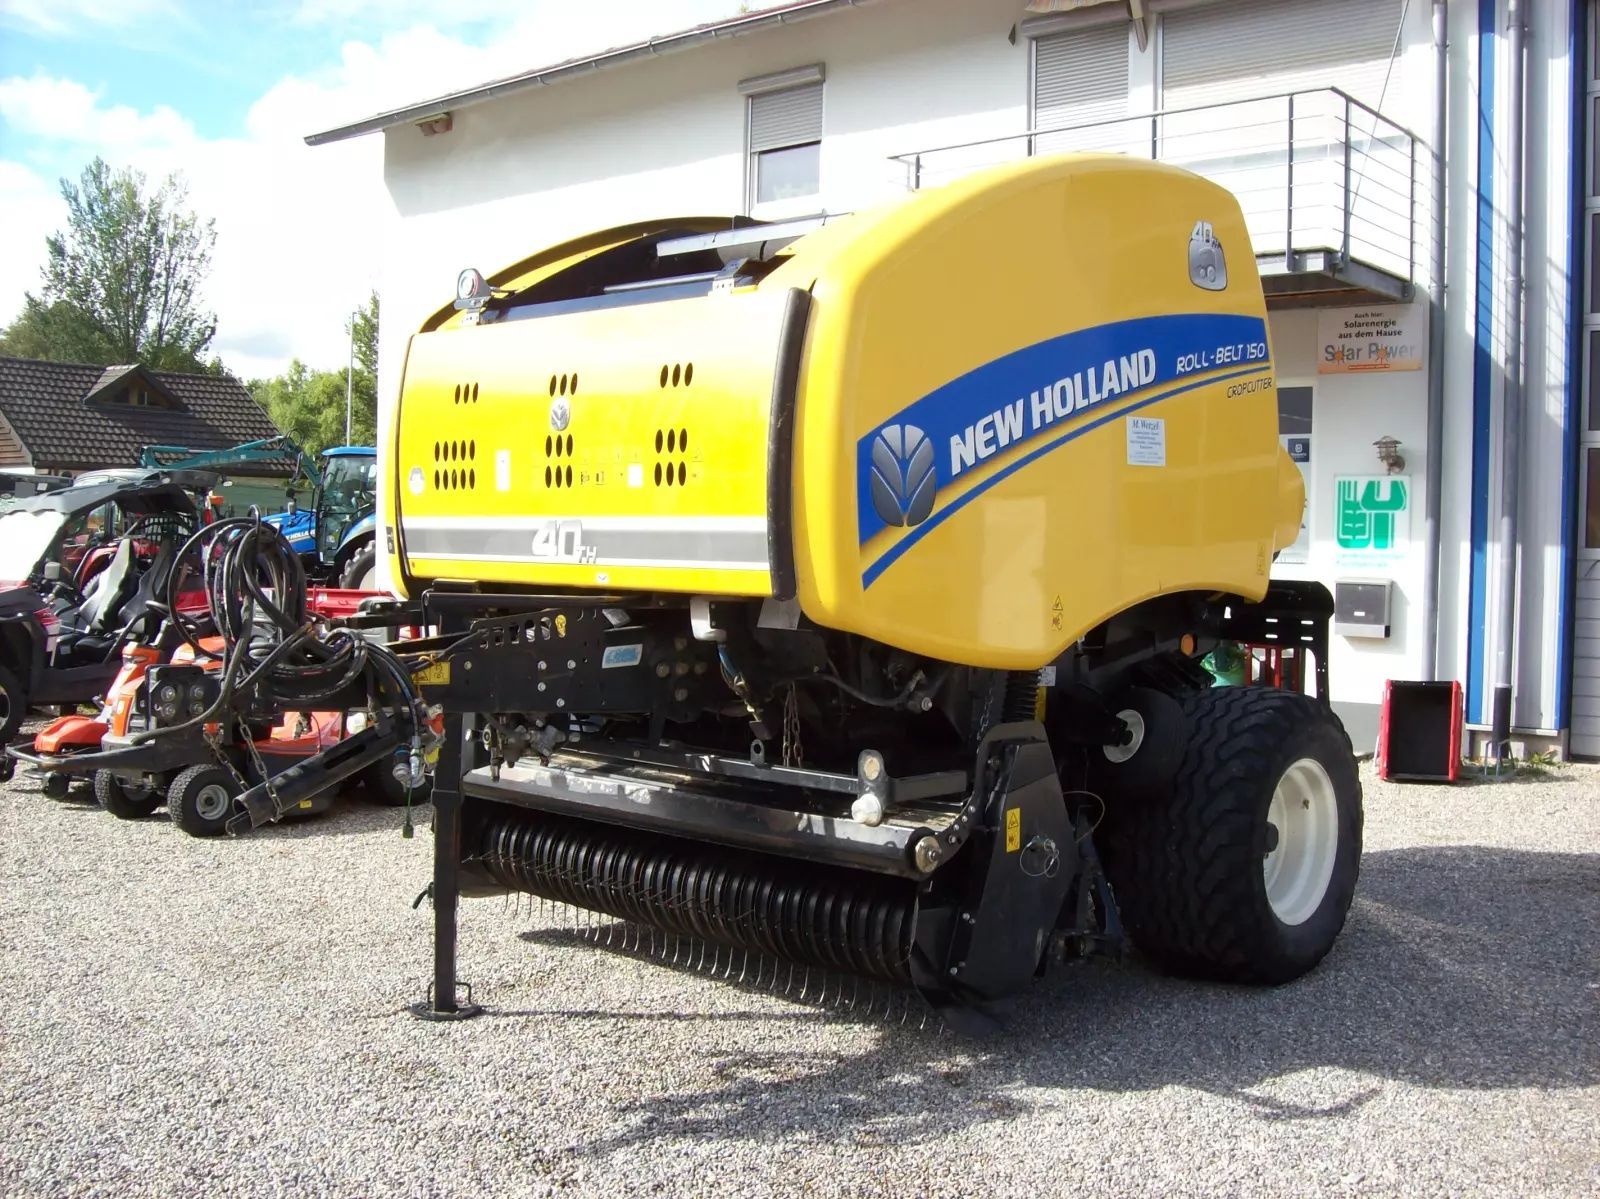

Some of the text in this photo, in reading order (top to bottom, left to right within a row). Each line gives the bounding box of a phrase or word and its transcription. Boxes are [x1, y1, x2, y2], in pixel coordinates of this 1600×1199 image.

[1344, 319, 1397, 329] Solarenergie
[1354, 330, 1374, 338] dem
[1376, 329, 1403, 337] Hause
[1246, 343, 1266, 360] 150
[1227, 377, 1273, 399] CROPCUTTER
[950, 348, 1156, 476] NEW HOLLAND
